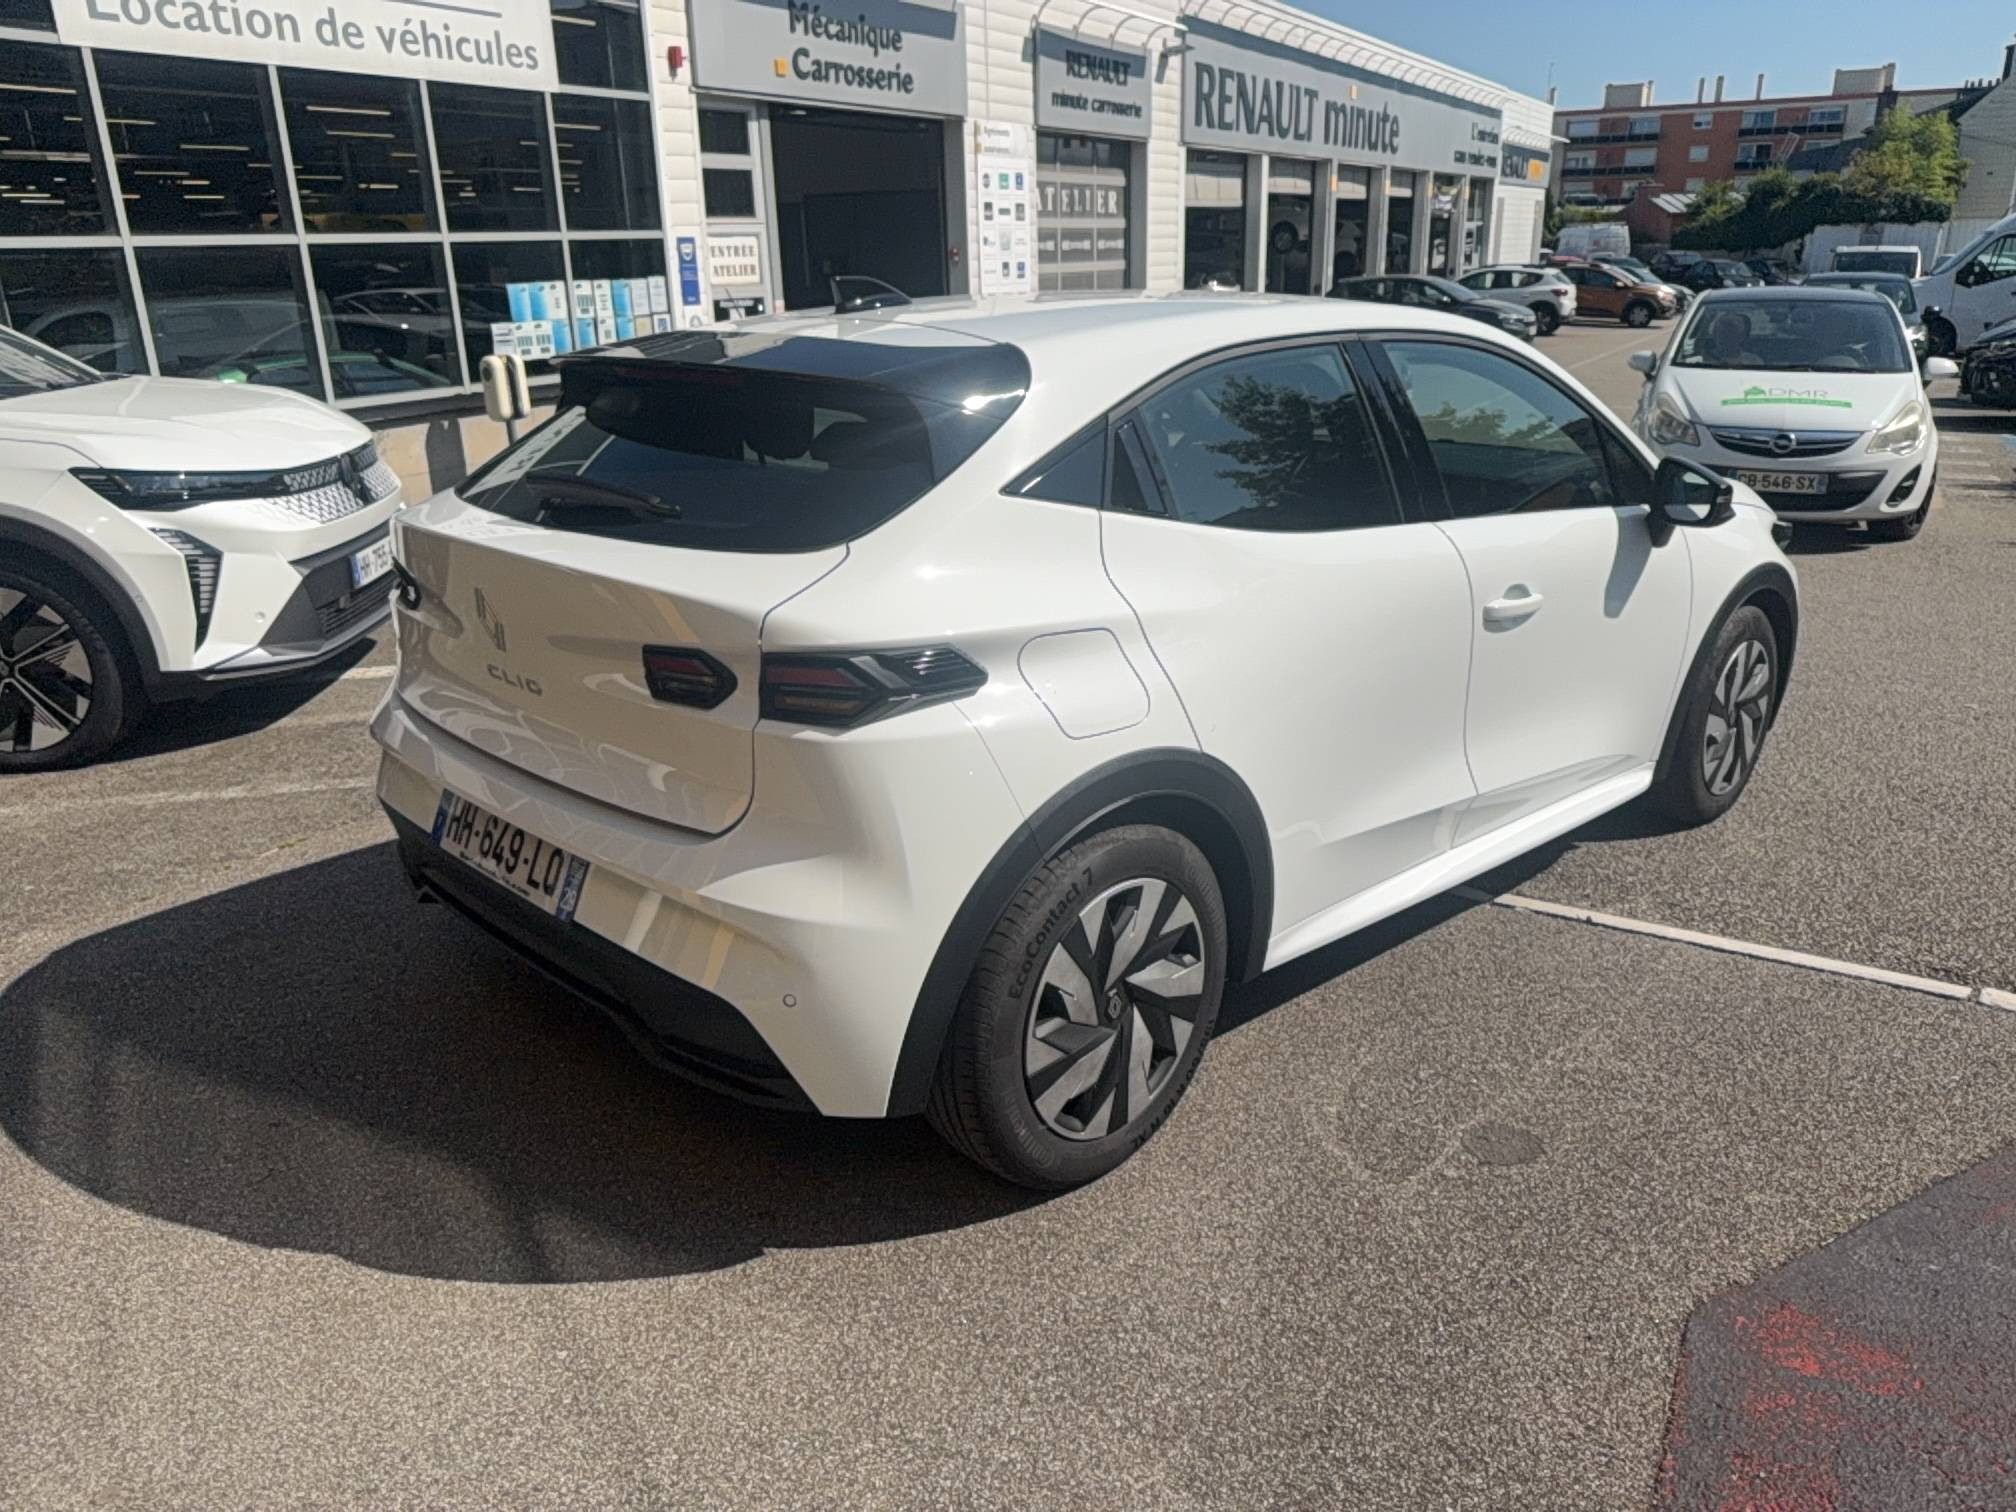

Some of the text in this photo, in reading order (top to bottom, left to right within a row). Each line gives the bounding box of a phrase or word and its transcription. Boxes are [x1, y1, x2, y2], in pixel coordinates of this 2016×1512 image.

[315, 7, 365, 50] de
[376, 18, 539, 70] véhicules
[787, 0, 903, 57] Mécanique
[792, 47, 914, 94] Carrosserie
[1066, 49, 1131, 87] RENAULT
[1195, 61, 1400, 154] RENAULT minute
[713, 264, 757, 277] ATELIER
[1007, 882, 1081, 998] EcoContact
